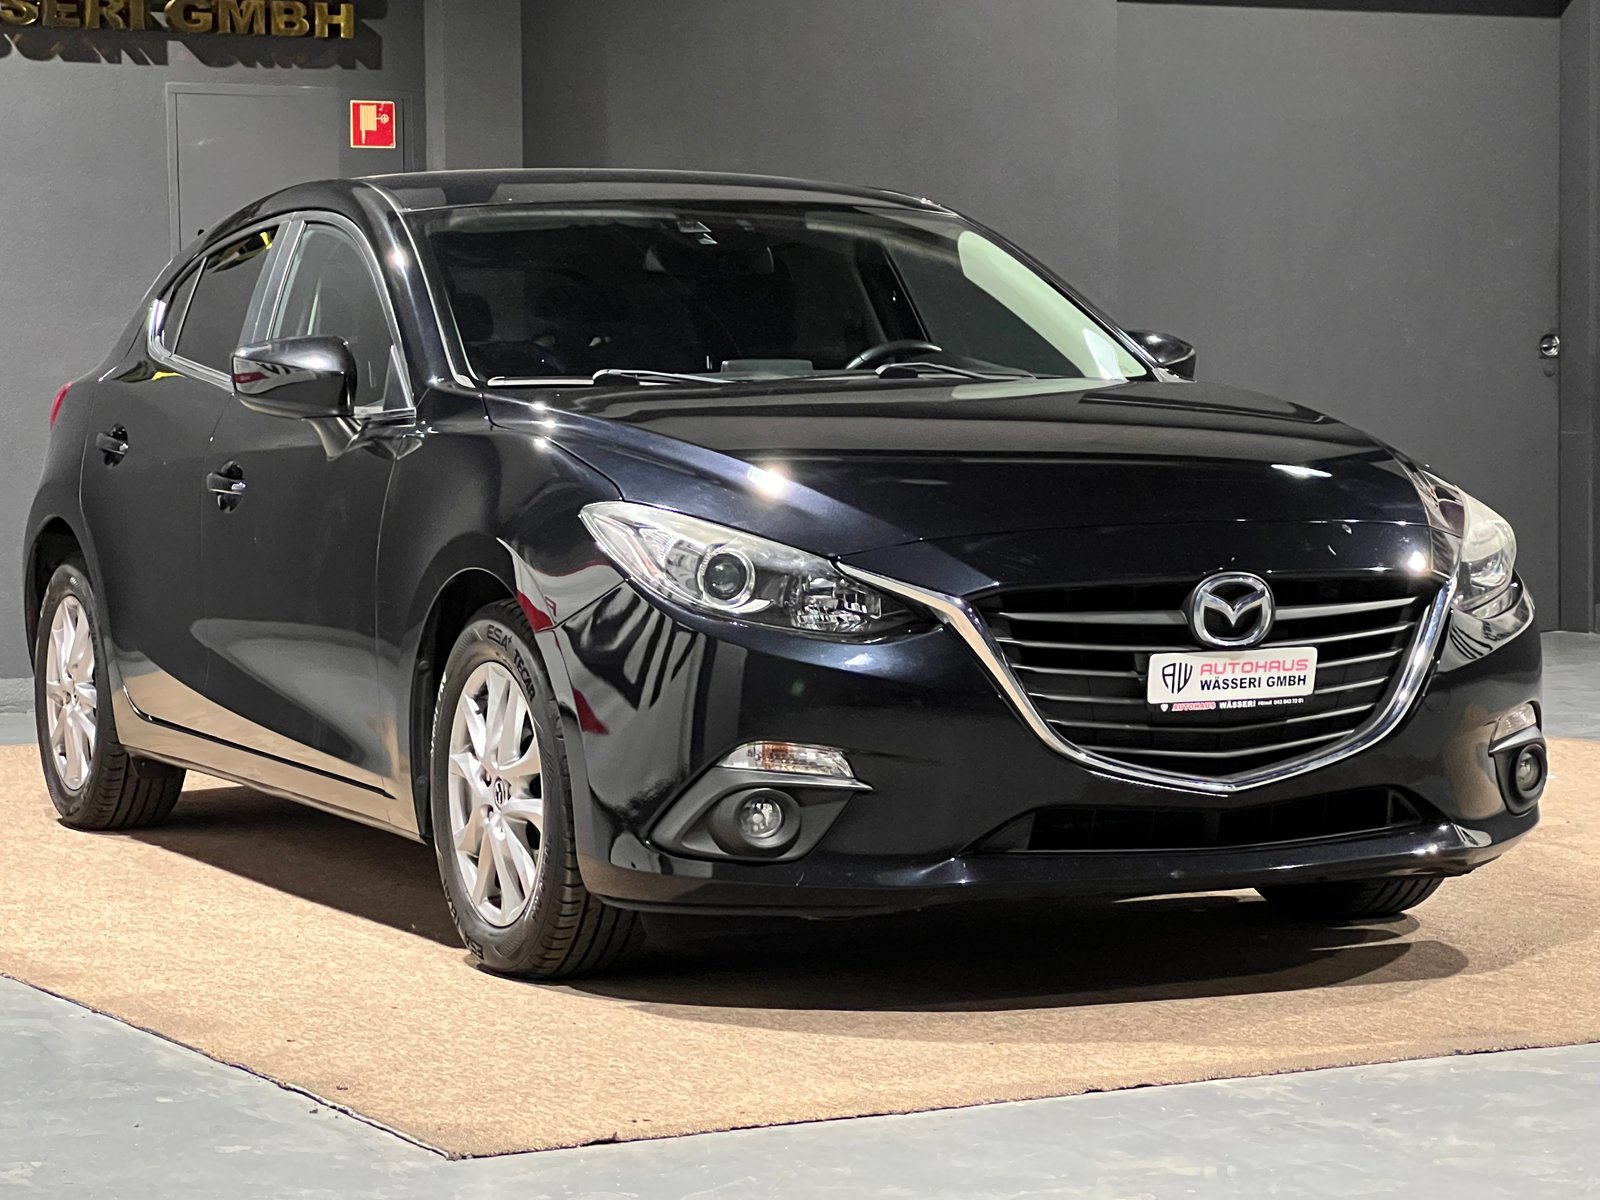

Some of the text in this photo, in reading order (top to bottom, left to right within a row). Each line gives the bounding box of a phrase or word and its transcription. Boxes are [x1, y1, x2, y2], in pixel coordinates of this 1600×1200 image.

[165, 0, 355, 39] GMBH
[513, 648, 536, 703] TECAR
[1200, 659, 1309, 676] AUTOHAUS
[1200, 675, 1307, 691] WÄSSERI GMBH
[1171, 701, 1217, 712] AUTOHAUS
[1219, 700, 1256, 709] WÄSSERI
